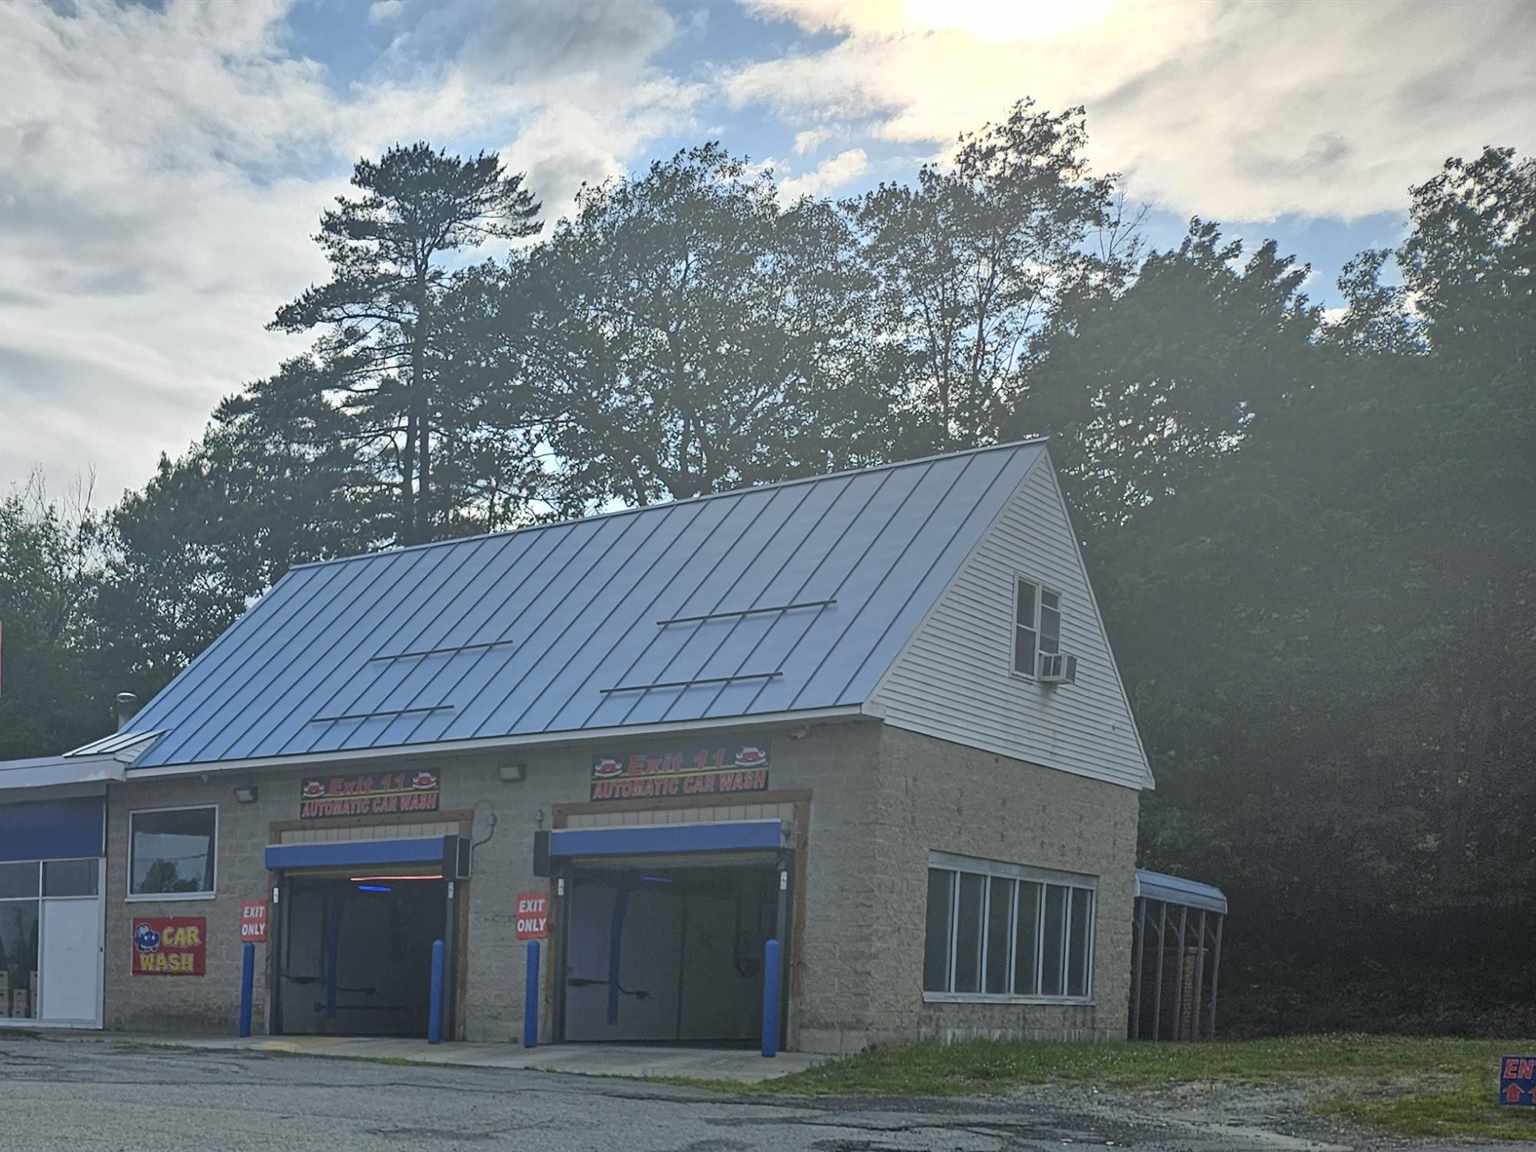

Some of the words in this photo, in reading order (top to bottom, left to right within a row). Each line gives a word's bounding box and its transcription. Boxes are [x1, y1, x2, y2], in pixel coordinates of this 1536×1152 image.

[628, 753, 682, 776] Exit
[592, 779, 679, 800] AUTOMATIC
[683, 775, 716, 794] CAR
[719, 769, 767, 791] WASH
[303, 798, 370, 818] AUTOMATIC
[372, 796, 398, 813] CAR
[400, 793, 437, 811] WASH
[243, 906, 265, 918] EXIT
[519, 899, 545, 912] EXIT
[241, 923, 266, 936] ONLY
[516, 918, 546, 932] ONLY
[162, 926, 200, 946] CAR
[139, 952, 194, 971] WASH
[1503, 1058, 1536, 1080] EN
